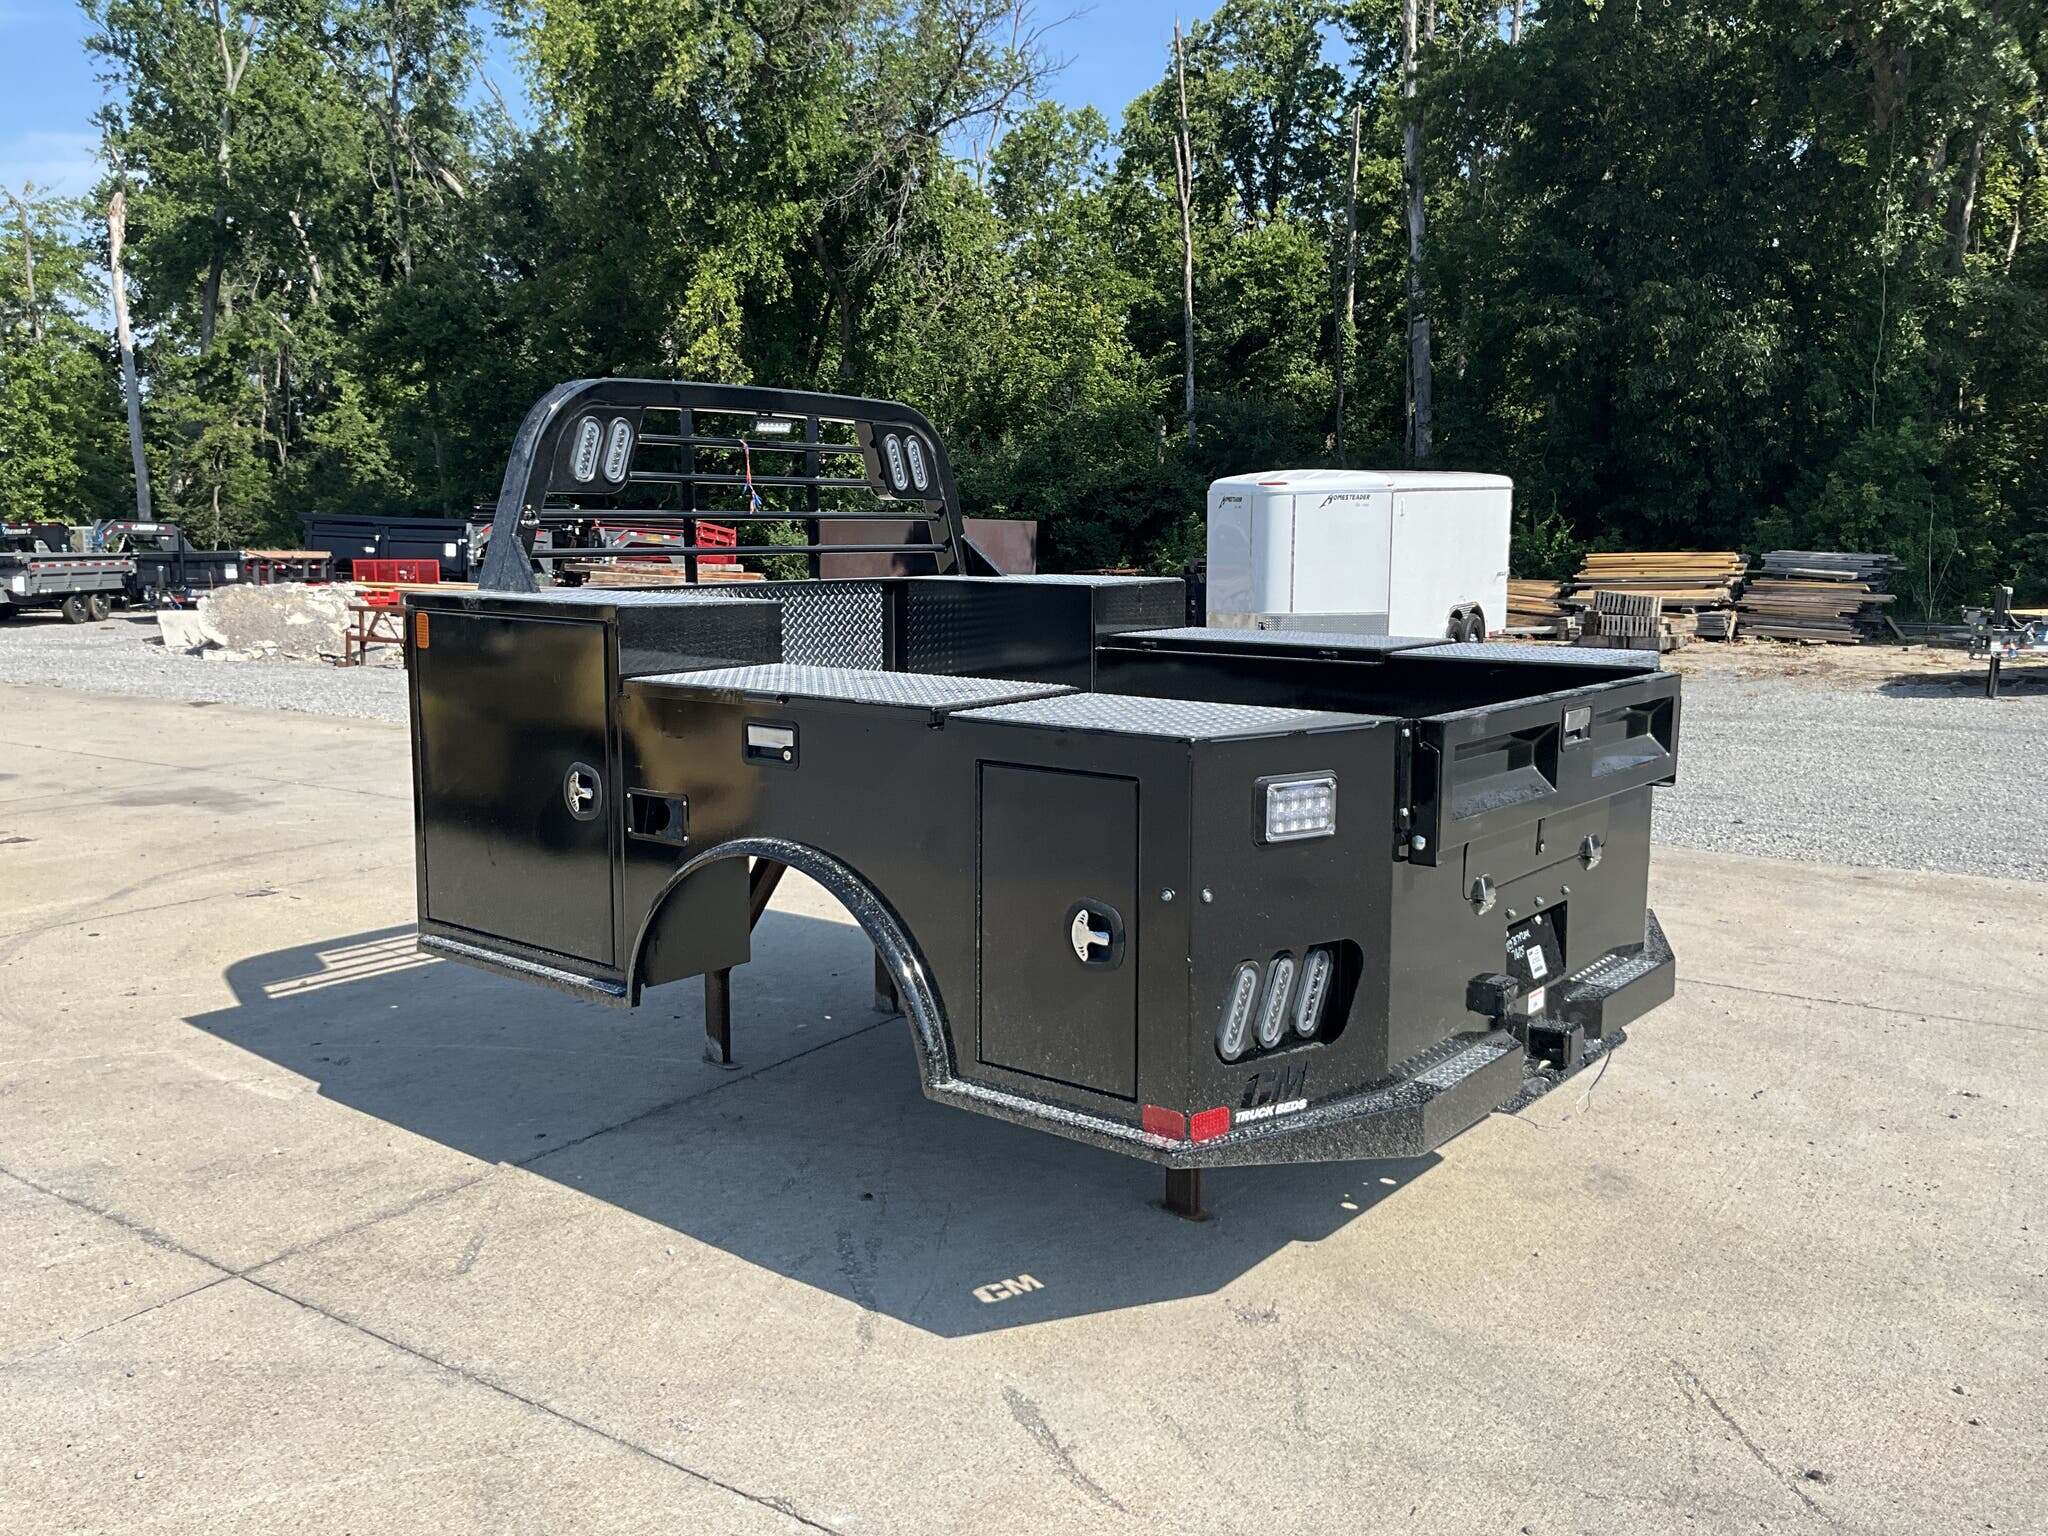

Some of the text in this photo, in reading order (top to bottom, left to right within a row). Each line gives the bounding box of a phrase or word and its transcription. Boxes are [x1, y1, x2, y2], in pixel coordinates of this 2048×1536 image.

[1235, 1098, 1308, 1123] TRUCK BEDS
[972, 1274, 1045, 1303] CM
